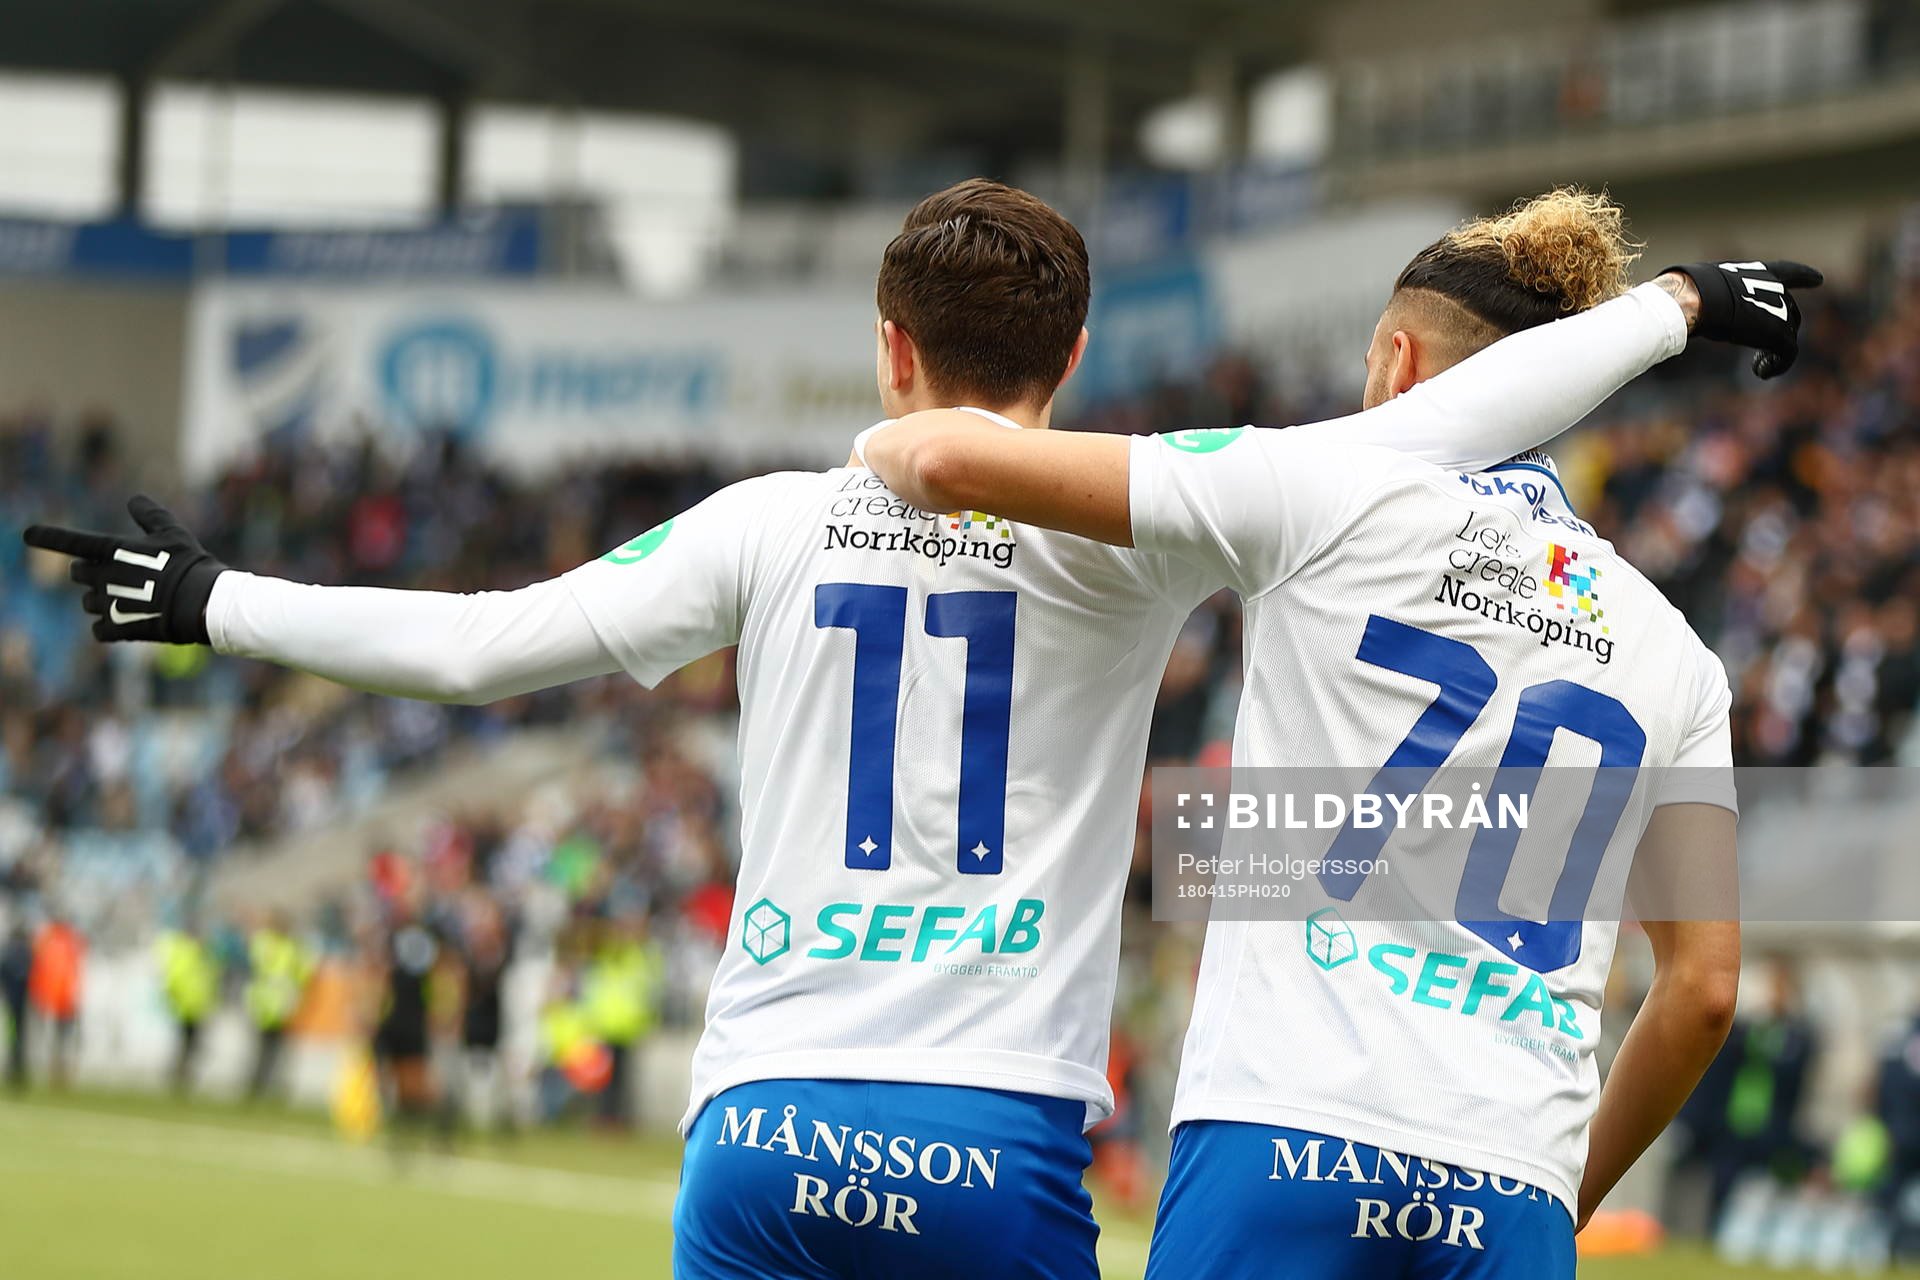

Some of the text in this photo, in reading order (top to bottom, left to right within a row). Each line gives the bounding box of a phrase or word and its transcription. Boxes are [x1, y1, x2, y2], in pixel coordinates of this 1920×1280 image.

[837, 473, 889, 492] Le
[824, 524, 1017, 569] Norrköping
[1449, 548, 1537, 599] create
[1434, 574, 1615, 664] Norrköping
[815, 583, 1017, 875] 11
[1314, 614, 1647, 974] 70
[807, 898, 1045, 962] SEFAB
[934, 963, 1038, 978] BYGGER FRAMTID
[1368, 943, 1584, 1040] SEFAB
[1549, 1042, 1579, 1064] FRAM
[716, 1104, 1001, 1190] MÅNSSON
[789, 1172, 920, 1235] RÖR
[1350, 1191, 1485, 1250] RÖR
